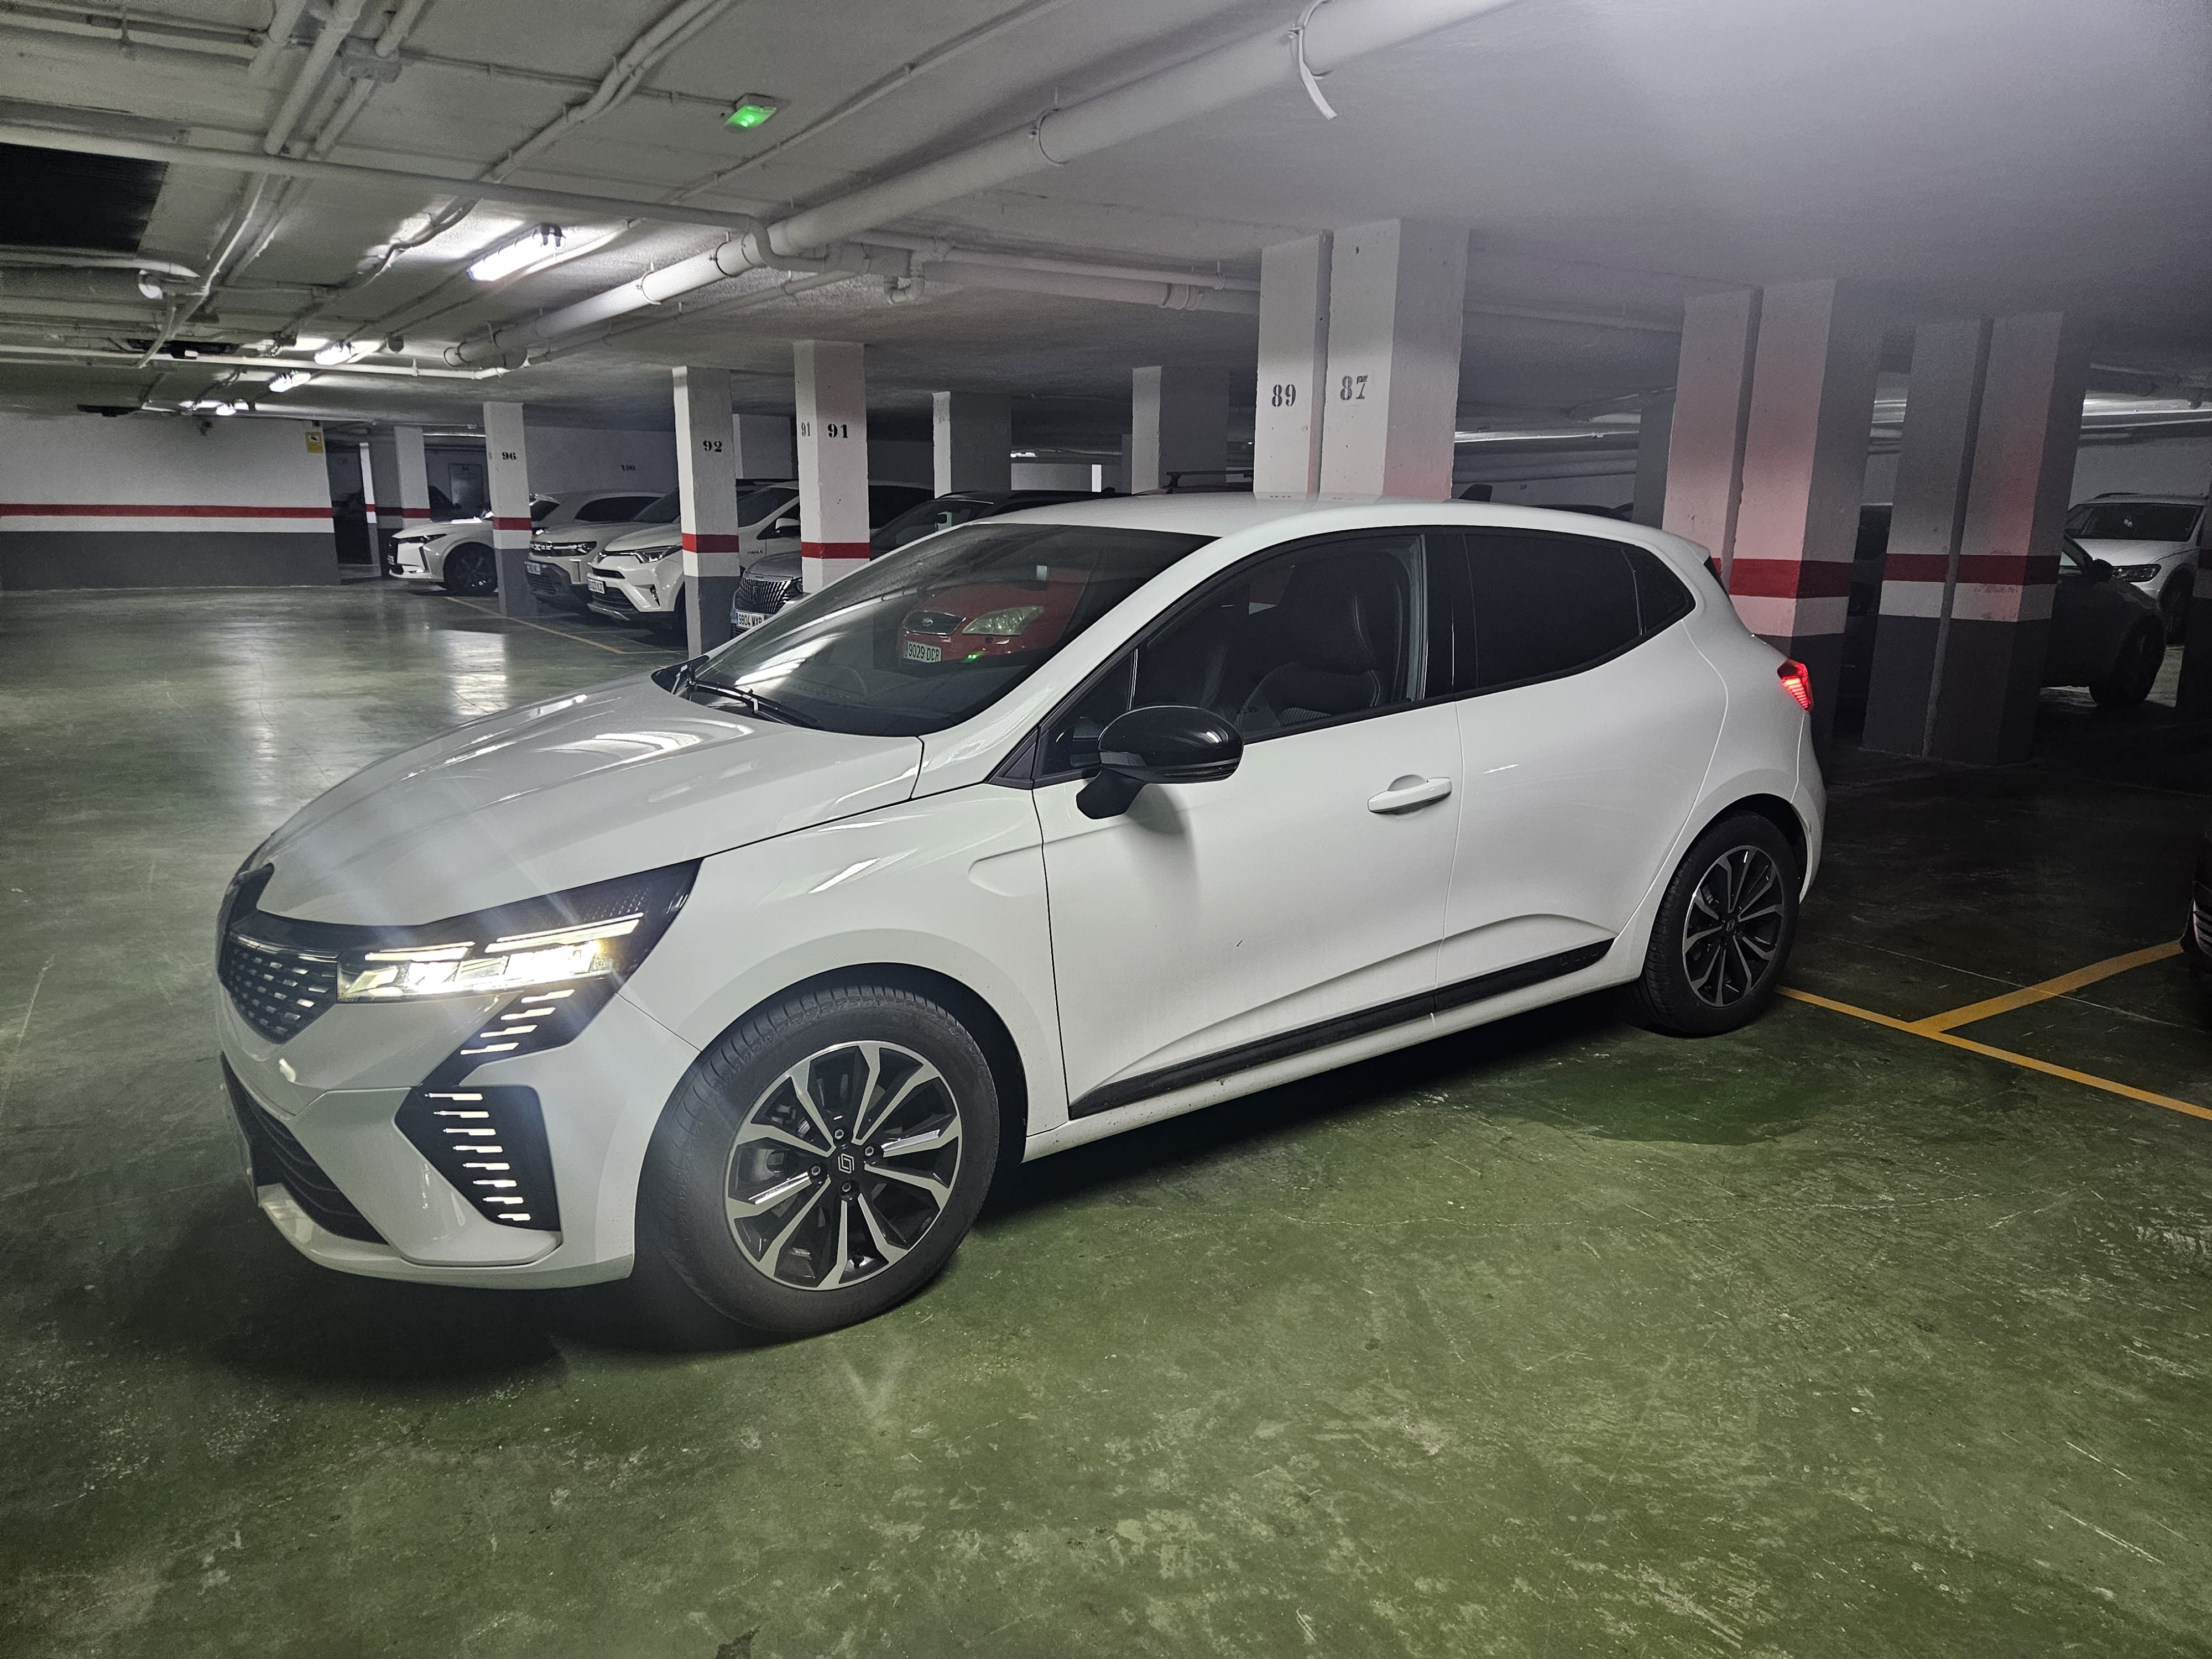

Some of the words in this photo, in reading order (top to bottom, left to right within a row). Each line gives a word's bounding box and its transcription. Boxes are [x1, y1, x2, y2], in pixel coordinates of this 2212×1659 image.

[1340, 375, 1368, 400] 87
[1272, 384, 1296, 407] 89
[801, 422, 810, 436] 91
[828, 424, 848, 438] 91
[703, 440, 722, 452] 92
[502, 451, 517, 460] 96
[909, 644, 925, 659] 9029
[927, 648, 940, 662] DCR
